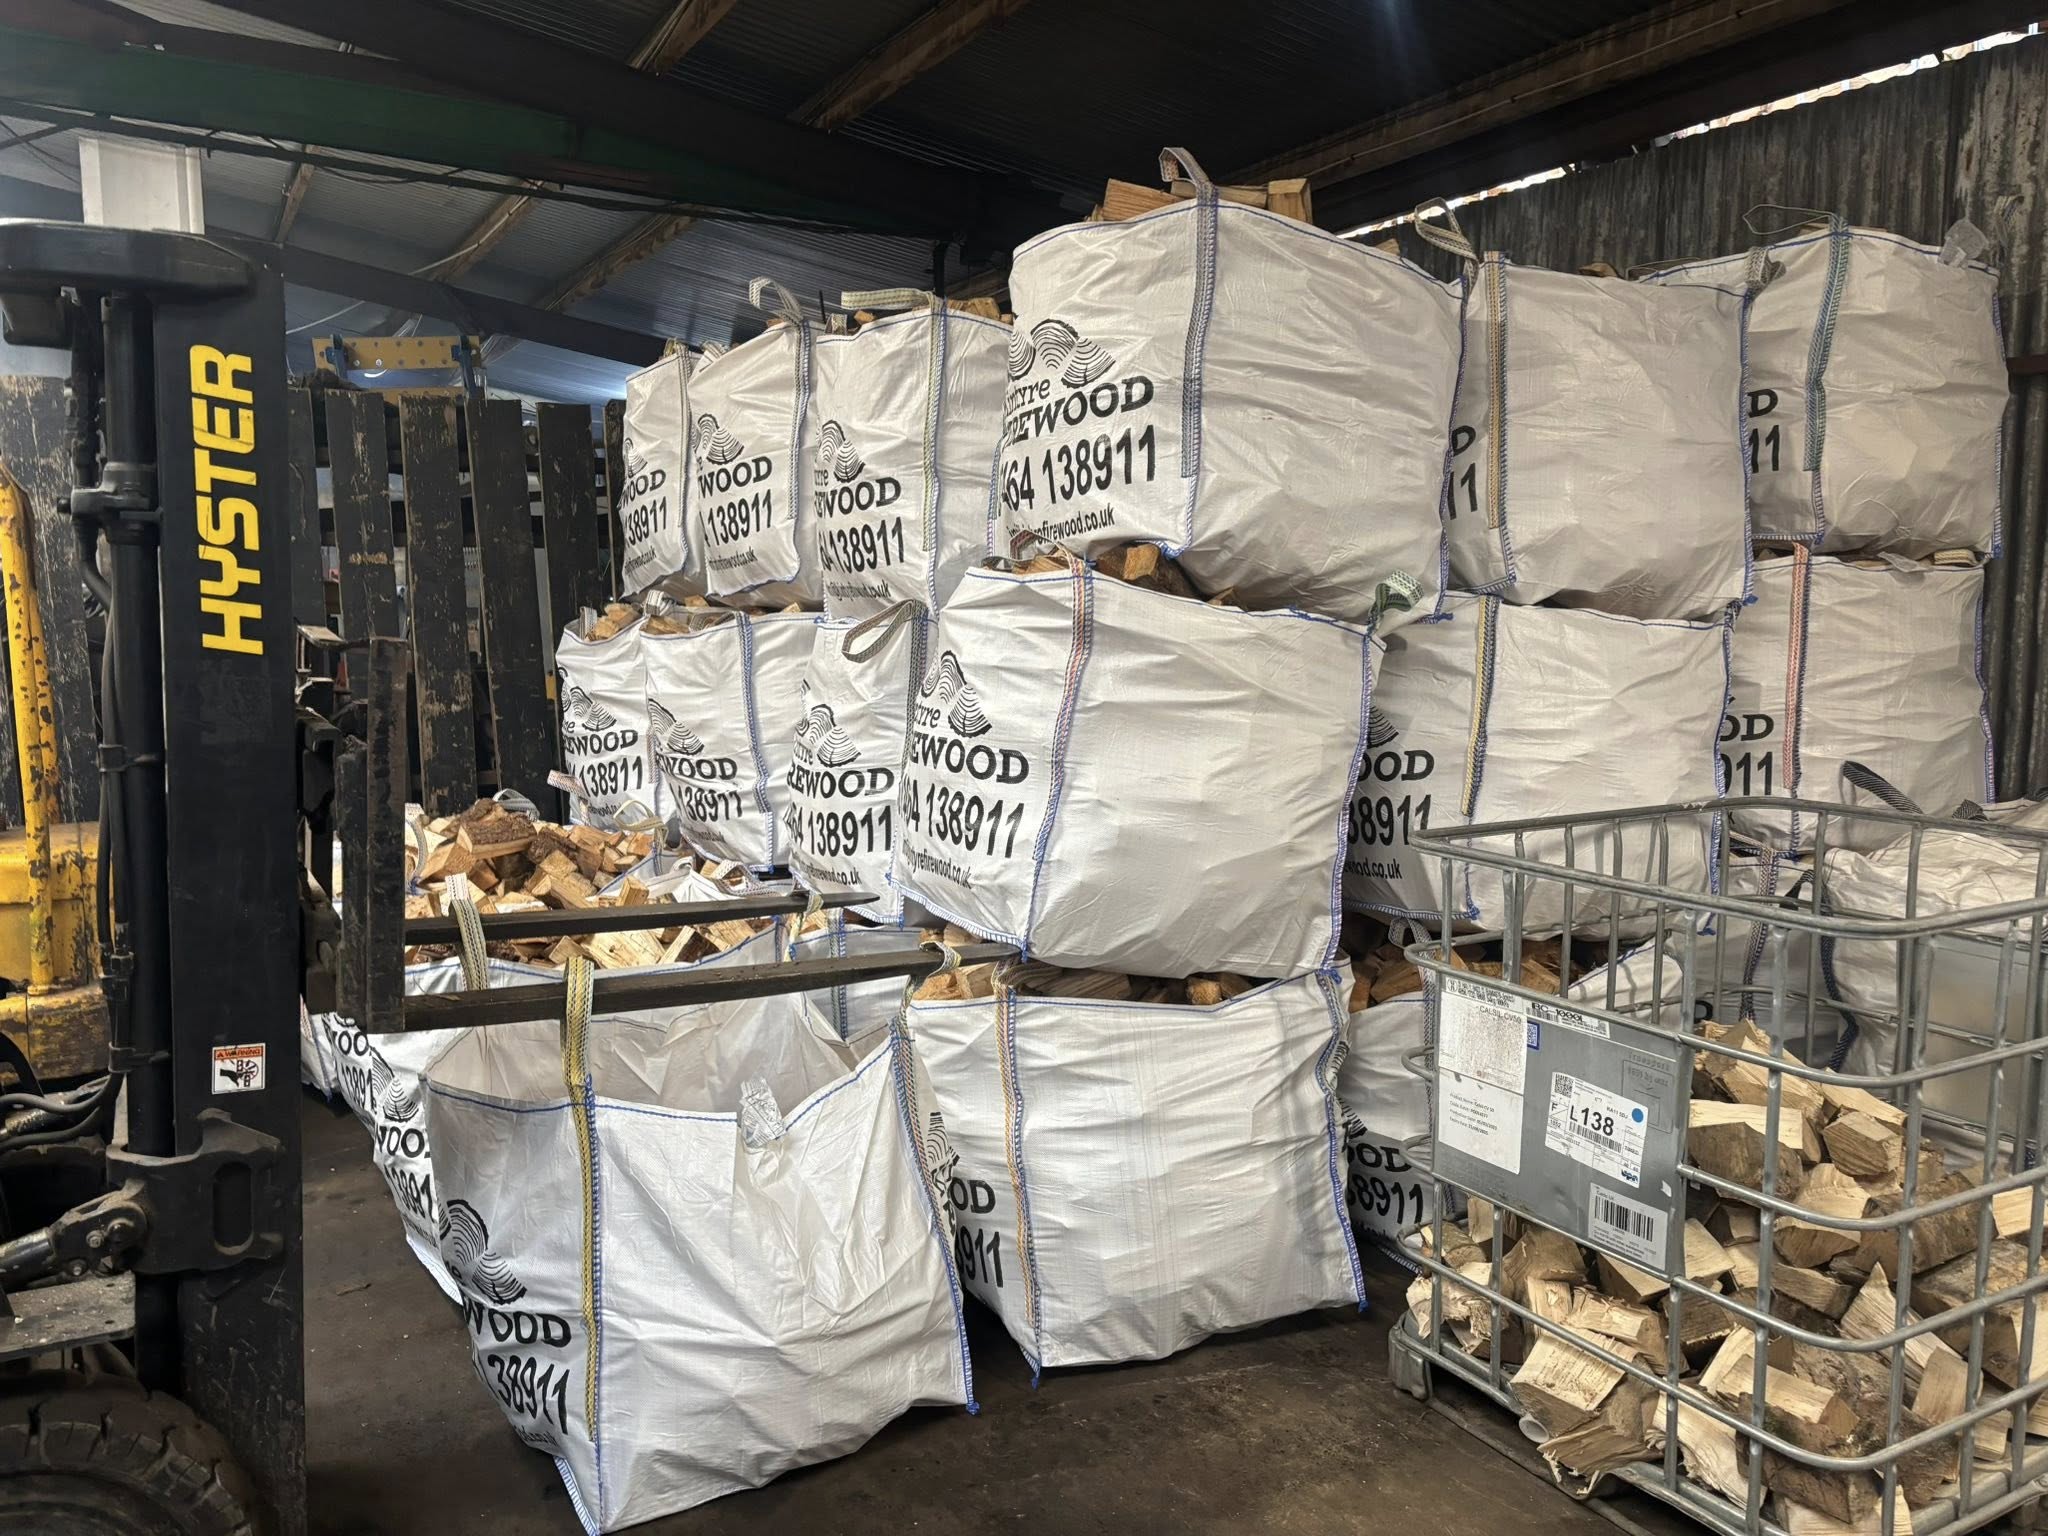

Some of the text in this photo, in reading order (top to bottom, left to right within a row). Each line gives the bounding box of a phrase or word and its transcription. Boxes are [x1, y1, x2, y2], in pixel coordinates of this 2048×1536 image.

[1747, 389, 1778, 418] D
[1042, 425, 1156, 504] 138911
[1452, 425, 1476, 456] D
[1749, 425, 1779, 474] 11
[190, 345, 263, 655] HYSTER
[708, 489, 772, 546] 138911
[829, 517, 904, 574] 138911
[579, 756, 643, 797] 138911
[808, 805, 891, 857] 138911
[926, 783, 1025, 859] 138911
[1569, 1105, 1615, 1136] L138
